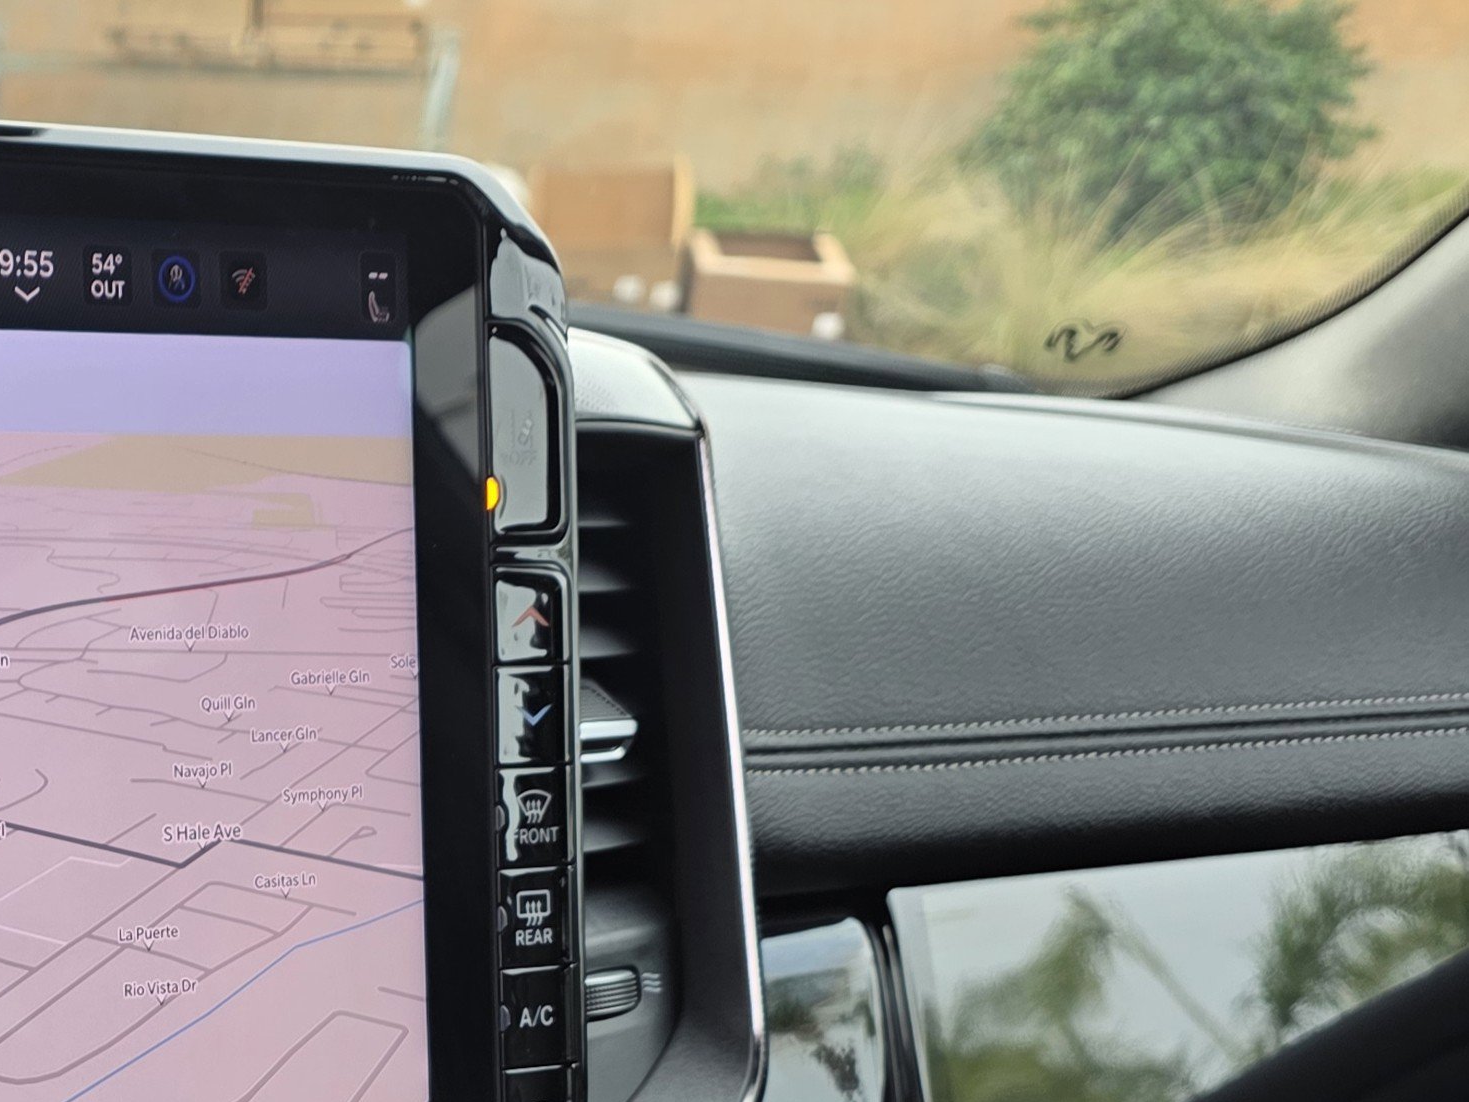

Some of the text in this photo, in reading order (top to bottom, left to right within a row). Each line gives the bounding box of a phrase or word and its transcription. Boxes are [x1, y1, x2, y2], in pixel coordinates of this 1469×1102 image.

[90, 279, 126, 299] OUT
[130, 625, 249, 641] Avenida del Diablo
[291, 670, 370, 686] Gabrielle Gln
[201, 696, 256, 711] Quill Gln
[251, 727, 318, 743] Lancer Gln
[174, 763, 232, 779] Navajo Pl
[283, 785, 363, 803] Symphony Pl
[163, 824, 241, 842] S Hale Ave
[512, 826, 559, 845] FRONT
[254, 874, 316, 889] Casitas Ln
[119, 926, 179, 942] La Puerte
[515, 927, 553, 946] REAR
[124, 979, 197, 997] Rio Vista Dr
[519, 1004, 554, 1028] A/C
